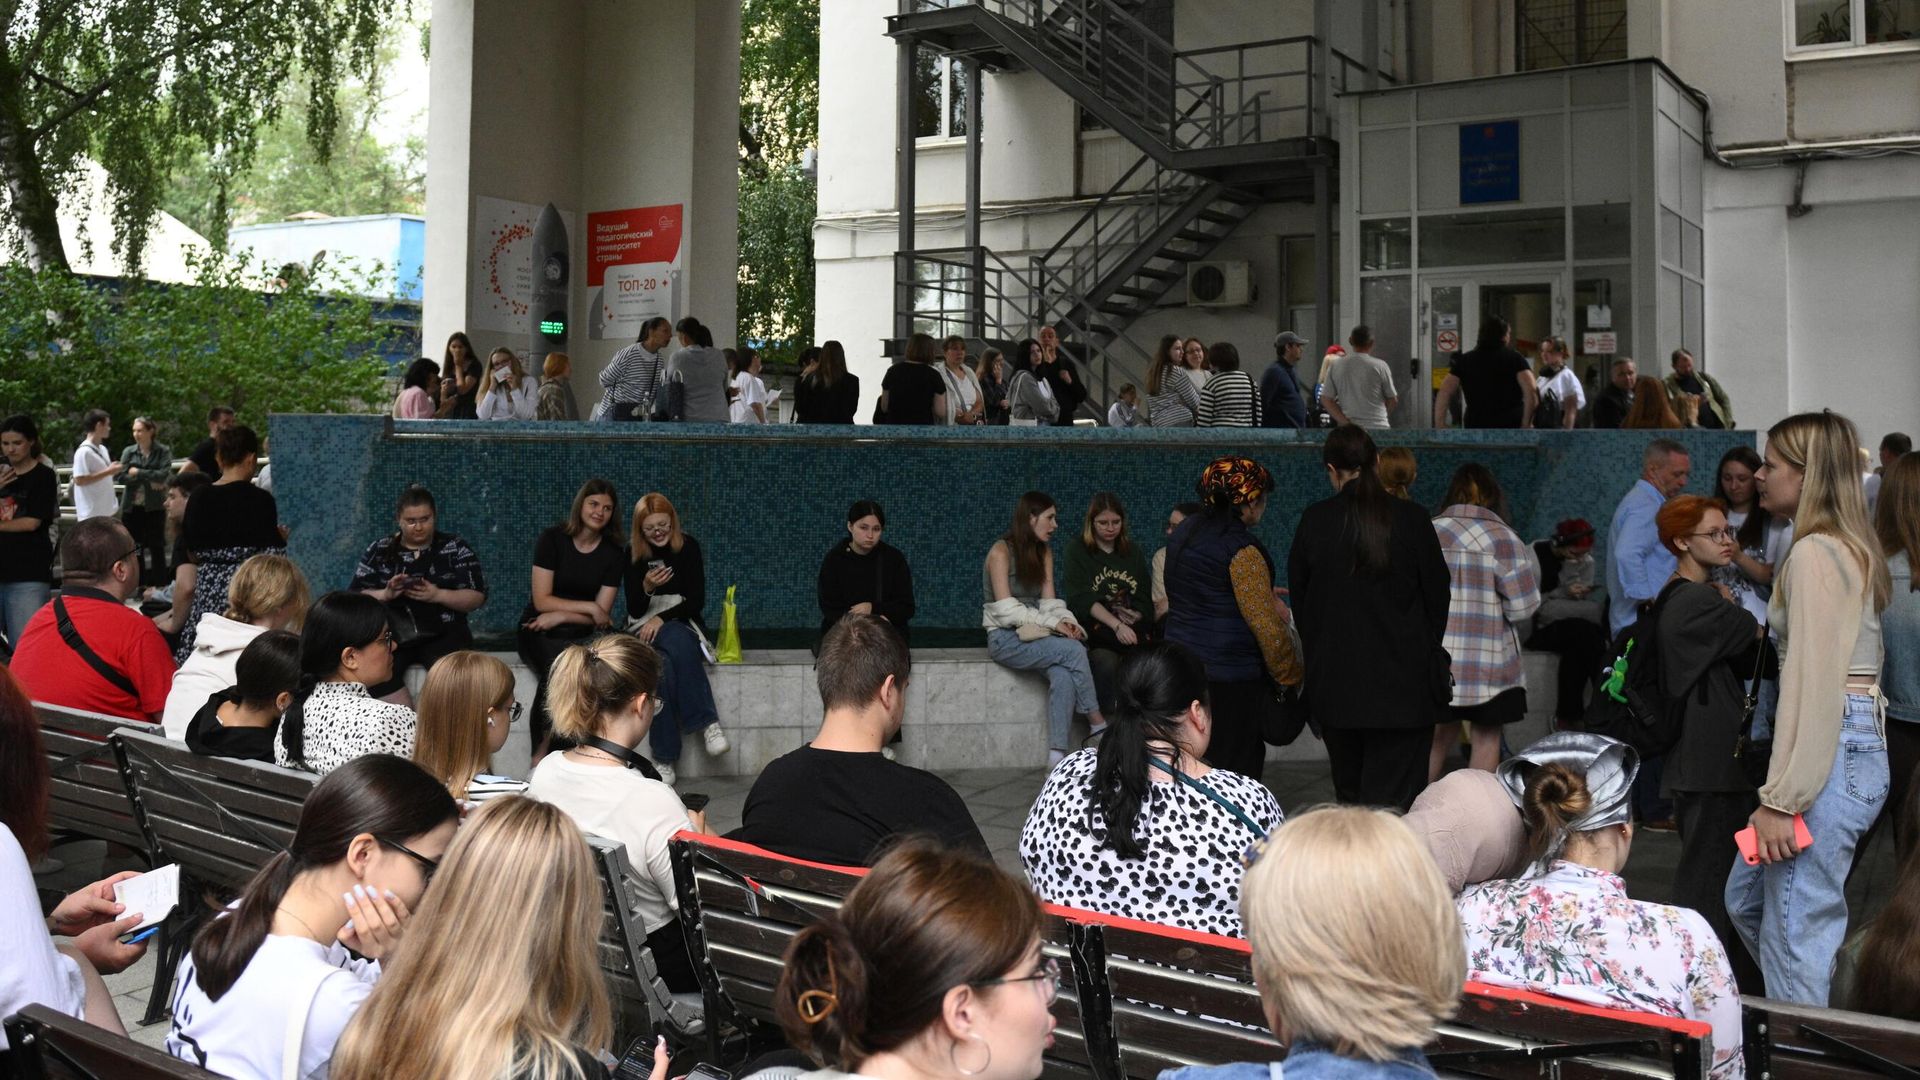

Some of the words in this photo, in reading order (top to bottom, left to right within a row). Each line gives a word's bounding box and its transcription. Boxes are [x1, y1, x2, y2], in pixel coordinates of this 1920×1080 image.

[596, 222, 629, 233] Ведущий
[596, 229, 653, 242] педагогический
[596, 242, 641, 253] университет
[596, 254, 622, 263] страны
[618, 278, 656, 291] ТОП-20
